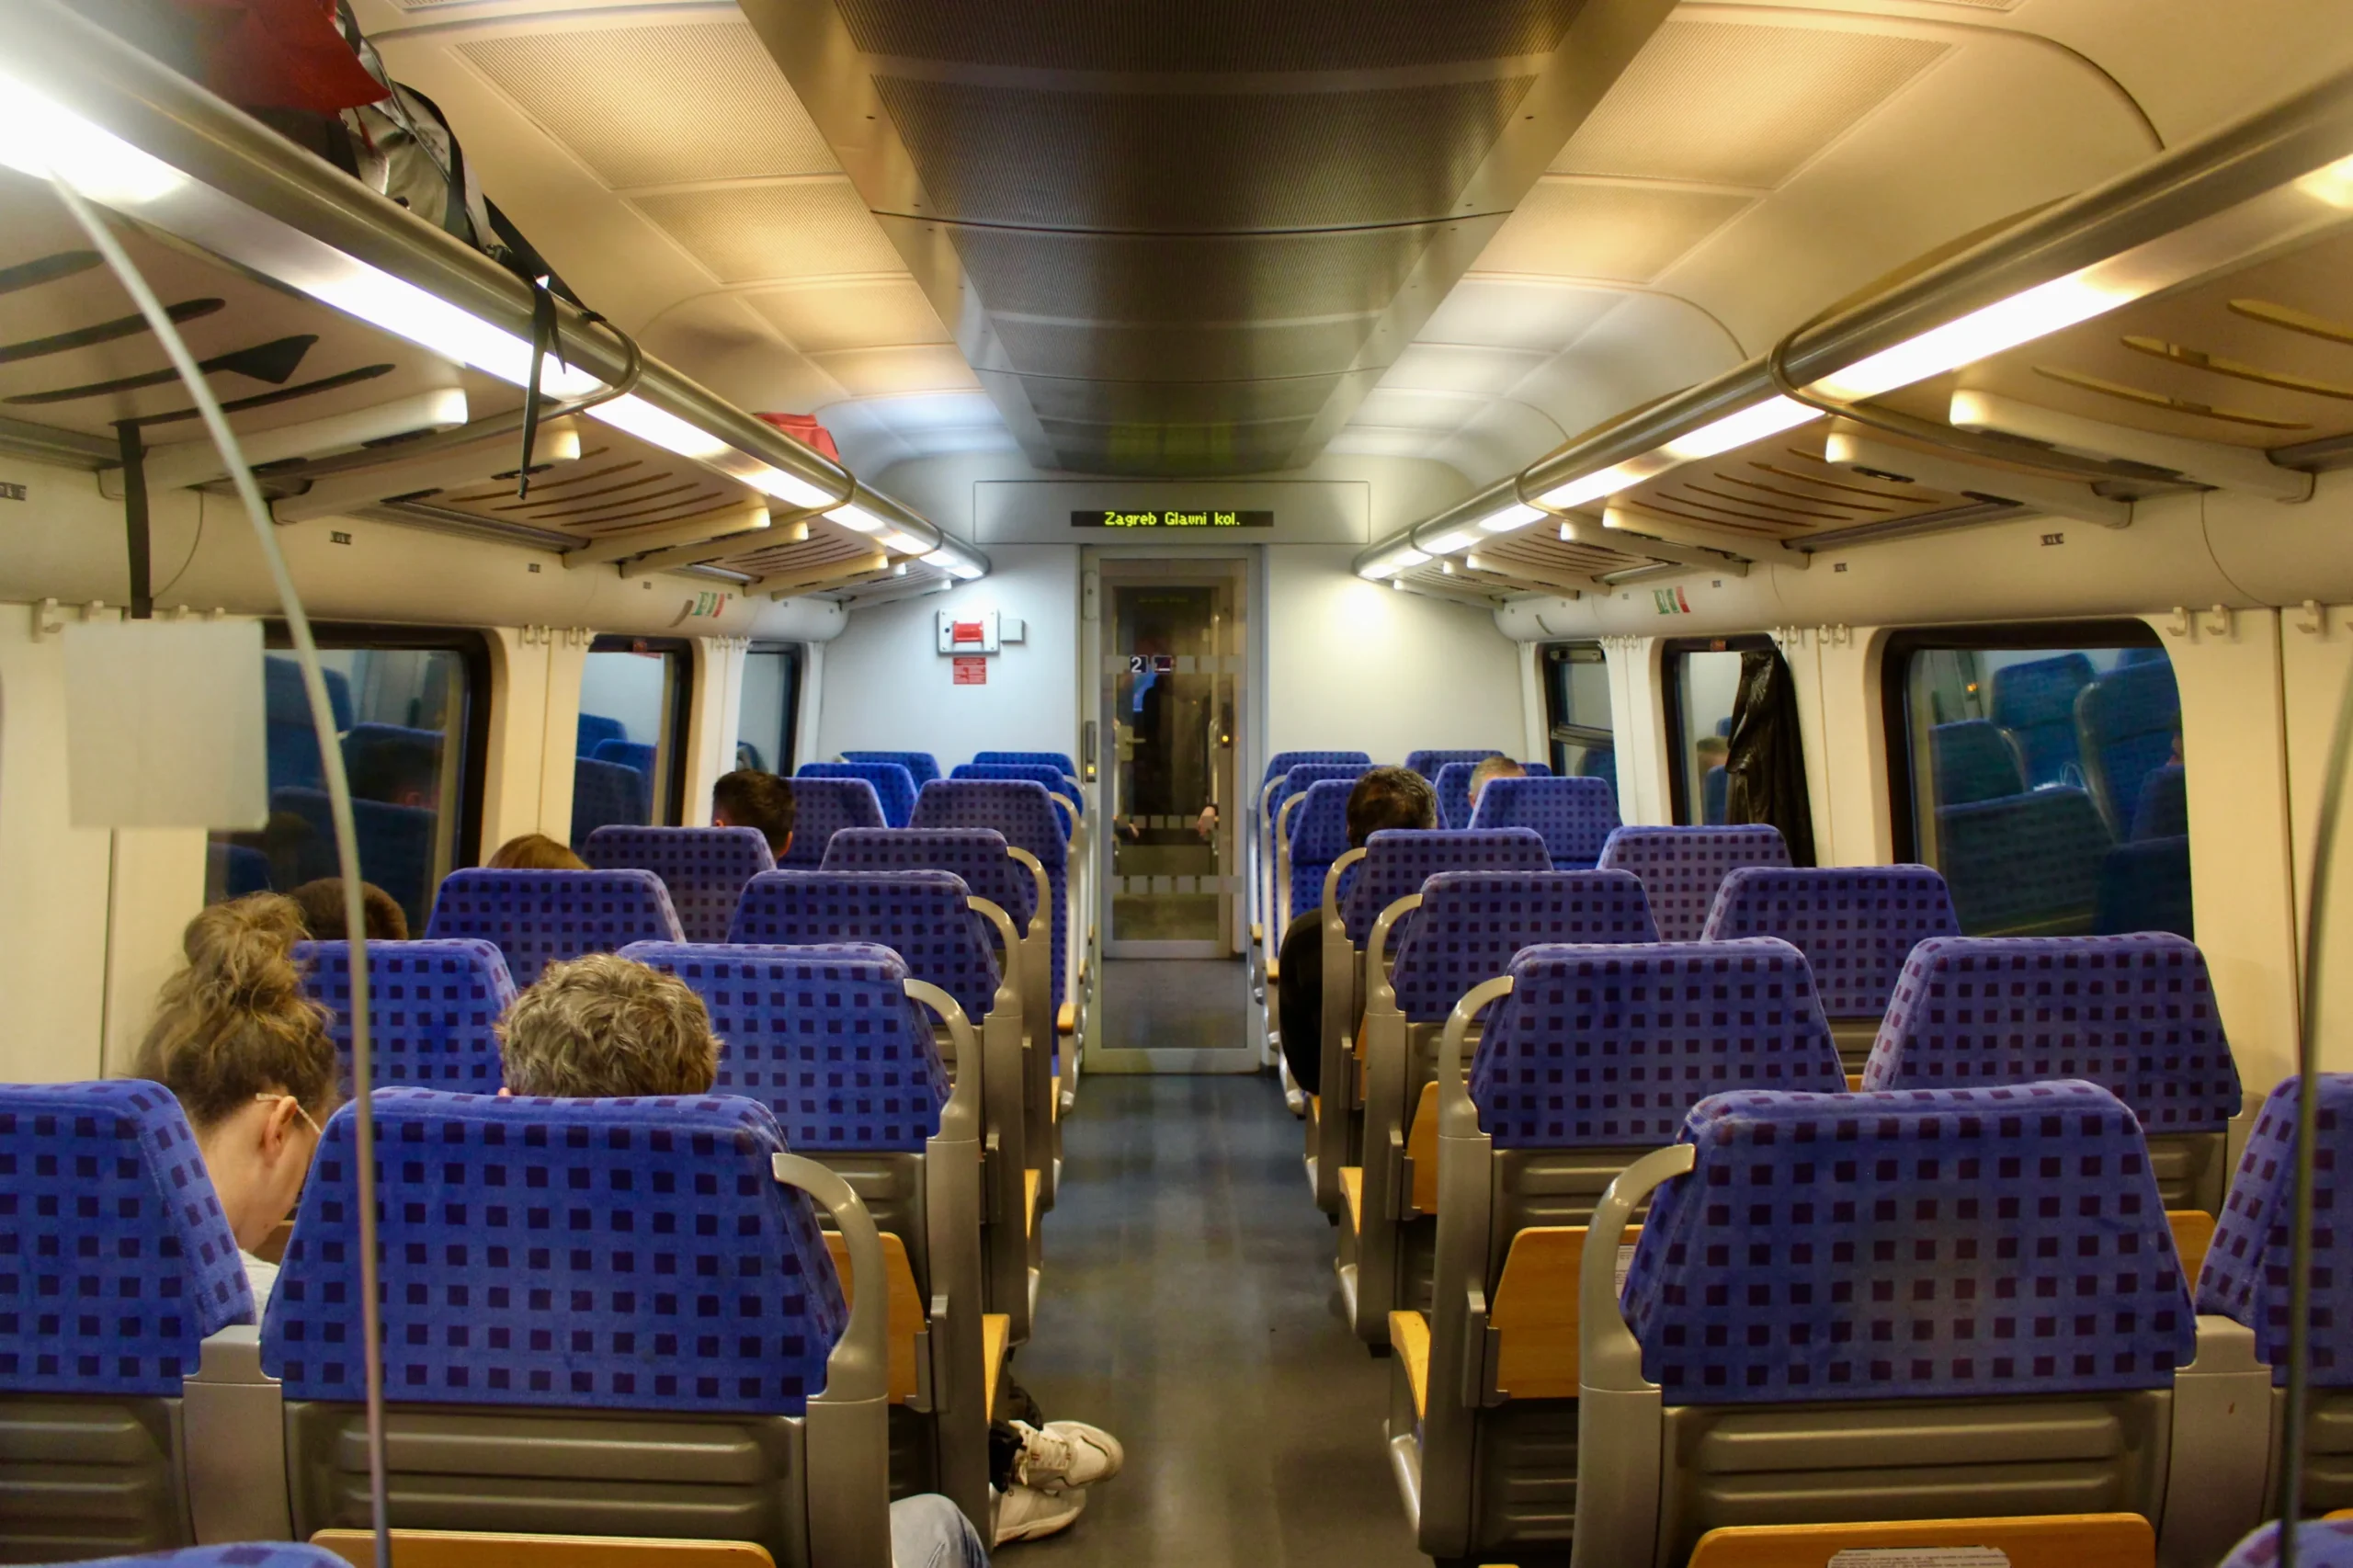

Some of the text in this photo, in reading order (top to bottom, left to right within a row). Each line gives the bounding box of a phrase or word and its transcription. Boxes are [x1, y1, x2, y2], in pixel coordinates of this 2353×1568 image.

[1104, 511, 1240, 527] Zagreb Glavni kol.
[1131, 656, 1142, 673] 2
